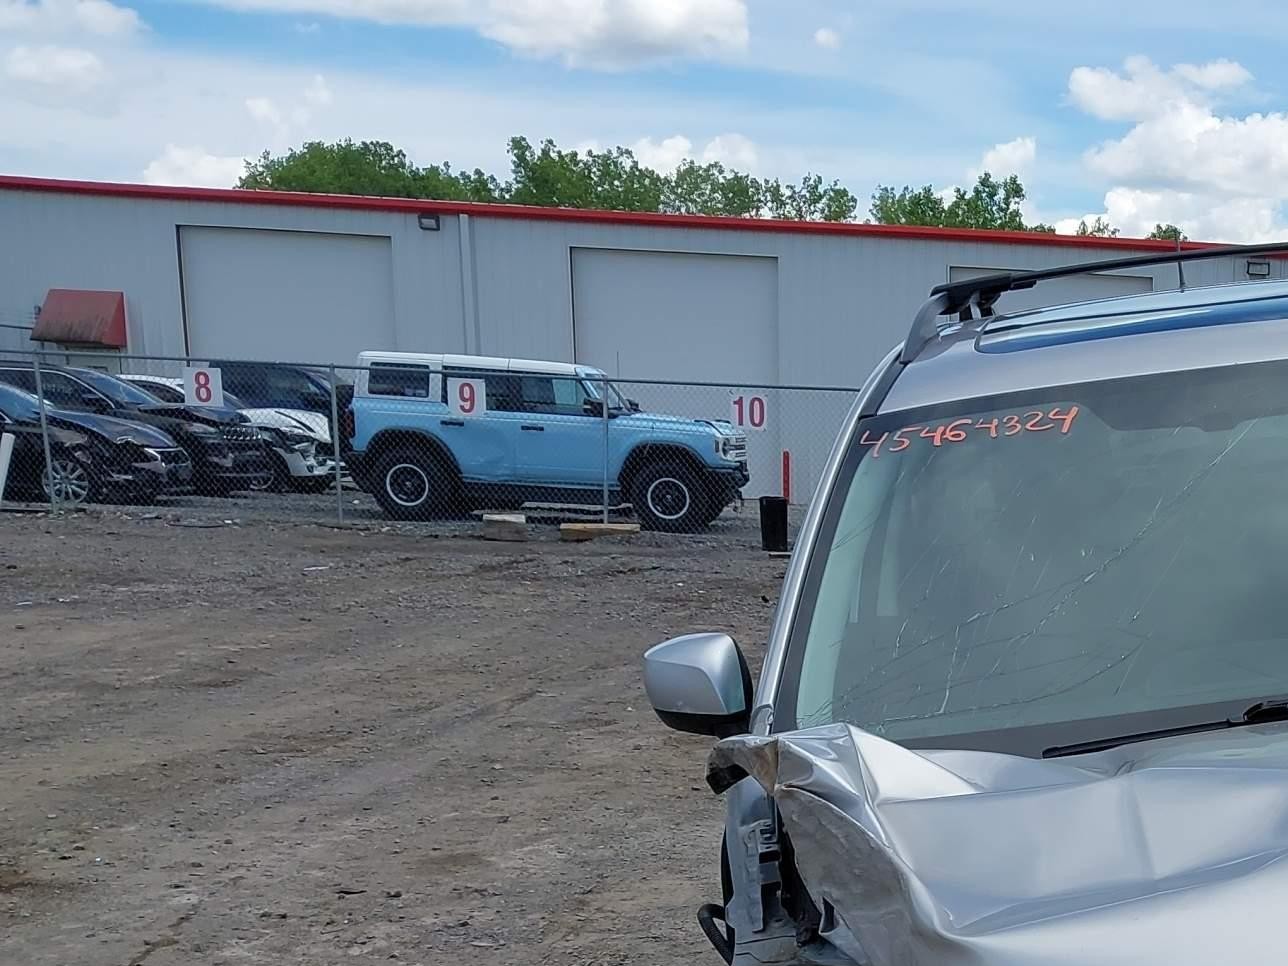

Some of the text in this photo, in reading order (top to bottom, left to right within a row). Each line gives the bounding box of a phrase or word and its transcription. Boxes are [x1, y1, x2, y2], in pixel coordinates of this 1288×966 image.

[194, 371, 212, 403] 8
[458, 382, 475, 413] 9
[732, 396, 765, 427] 10
[860, 406, 1079, 457] 45464324
